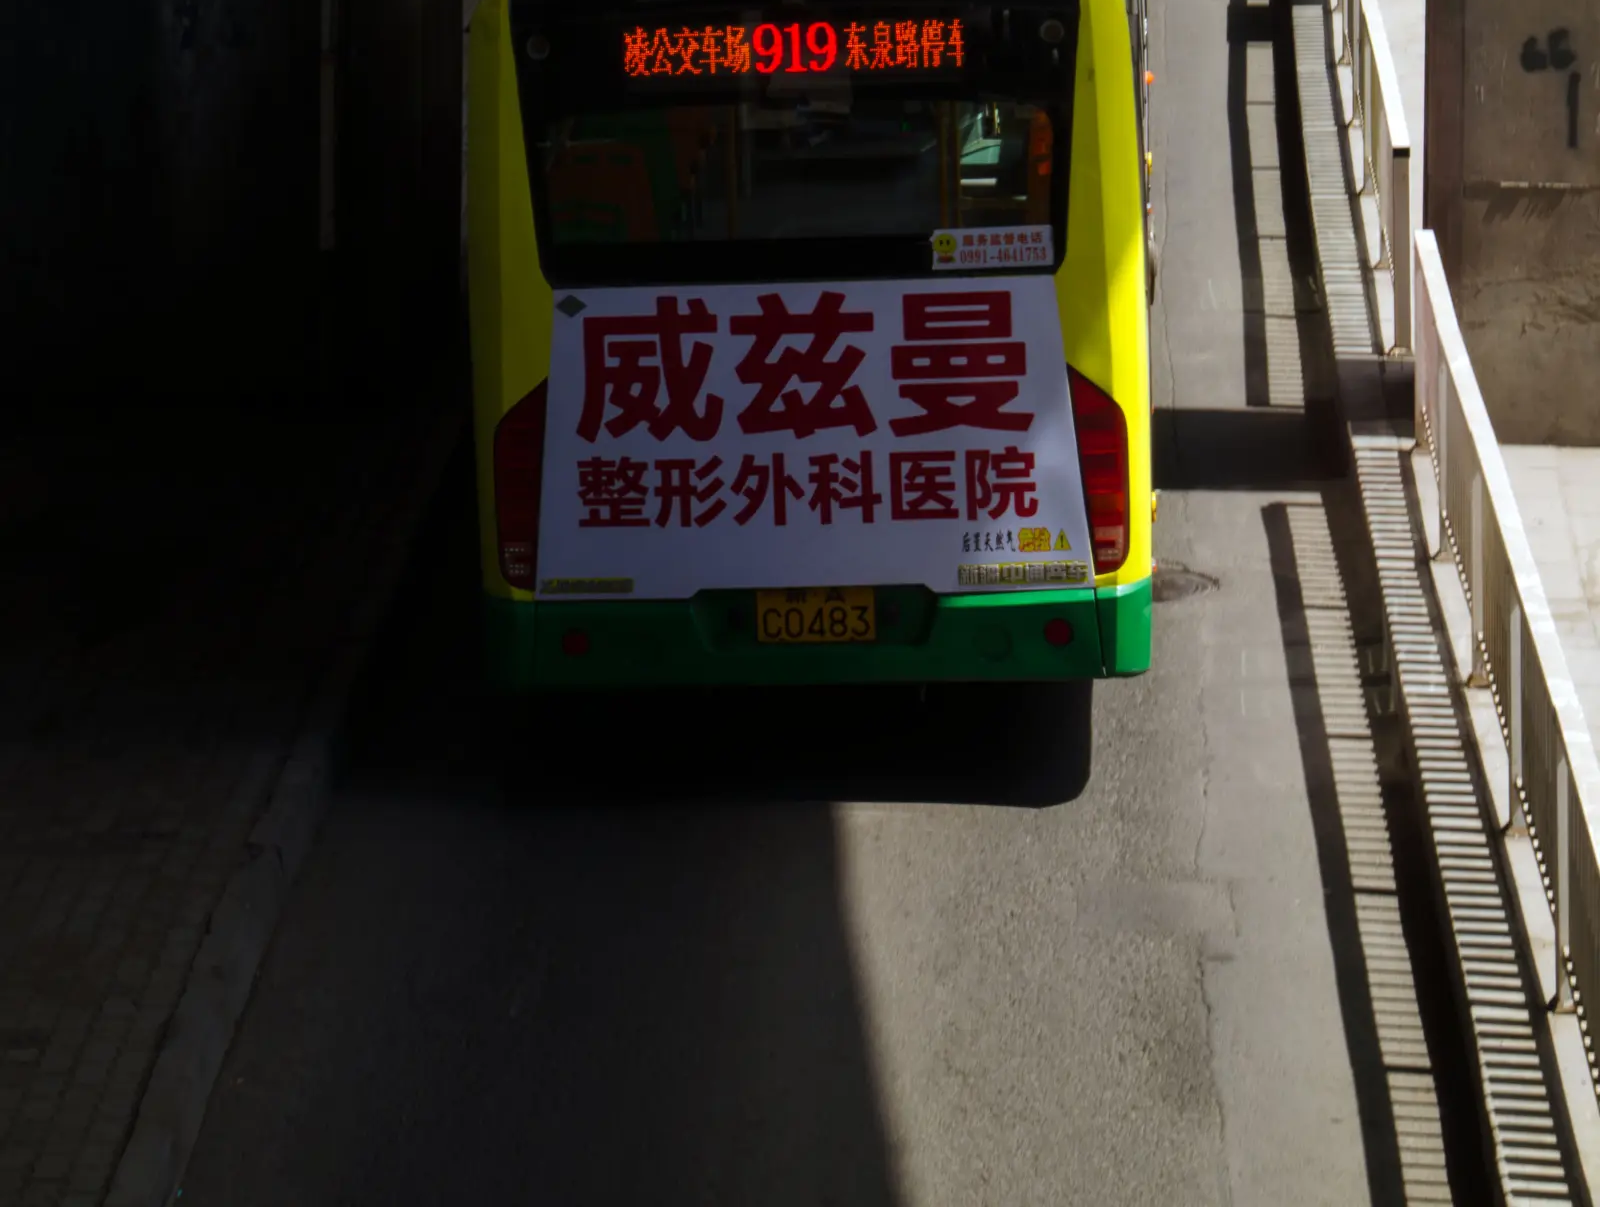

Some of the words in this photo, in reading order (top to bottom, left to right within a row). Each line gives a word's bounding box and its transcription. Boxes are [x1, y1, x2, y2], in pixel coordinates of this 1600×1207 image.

[752, 22, 838, 74] 919
[843, 18, 965, 71] 东泉路停车
[575, 291, 1035, 443] 威兹曼
[576, 446, 1039, 529] 整形外科医院
[762, 606, 871, 639] C0483
